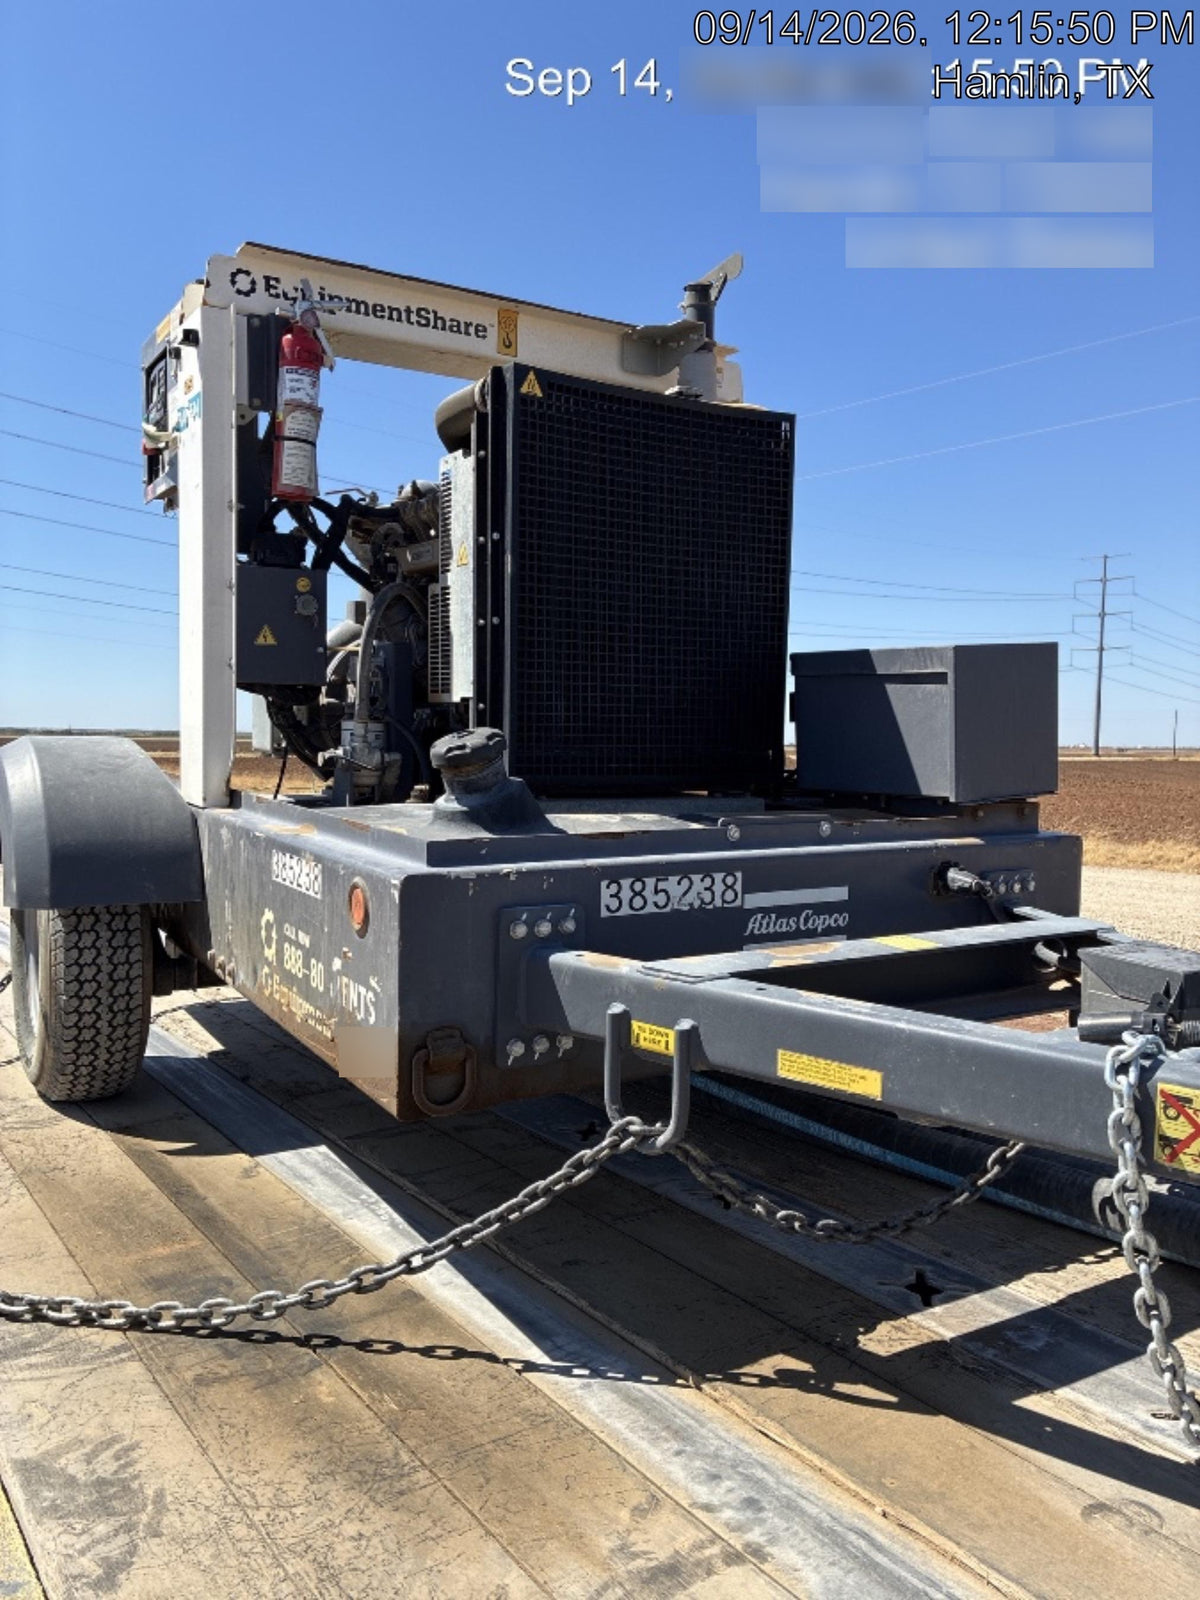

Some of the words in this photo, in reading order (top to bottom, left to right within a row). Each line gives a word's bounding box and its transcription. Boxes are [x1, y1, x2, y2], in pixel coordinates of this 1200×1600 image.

[605, 872, 738, 914] 385238
[743, 913, 798, 936] Atlas
[799, 909, 849, 933] Copco
